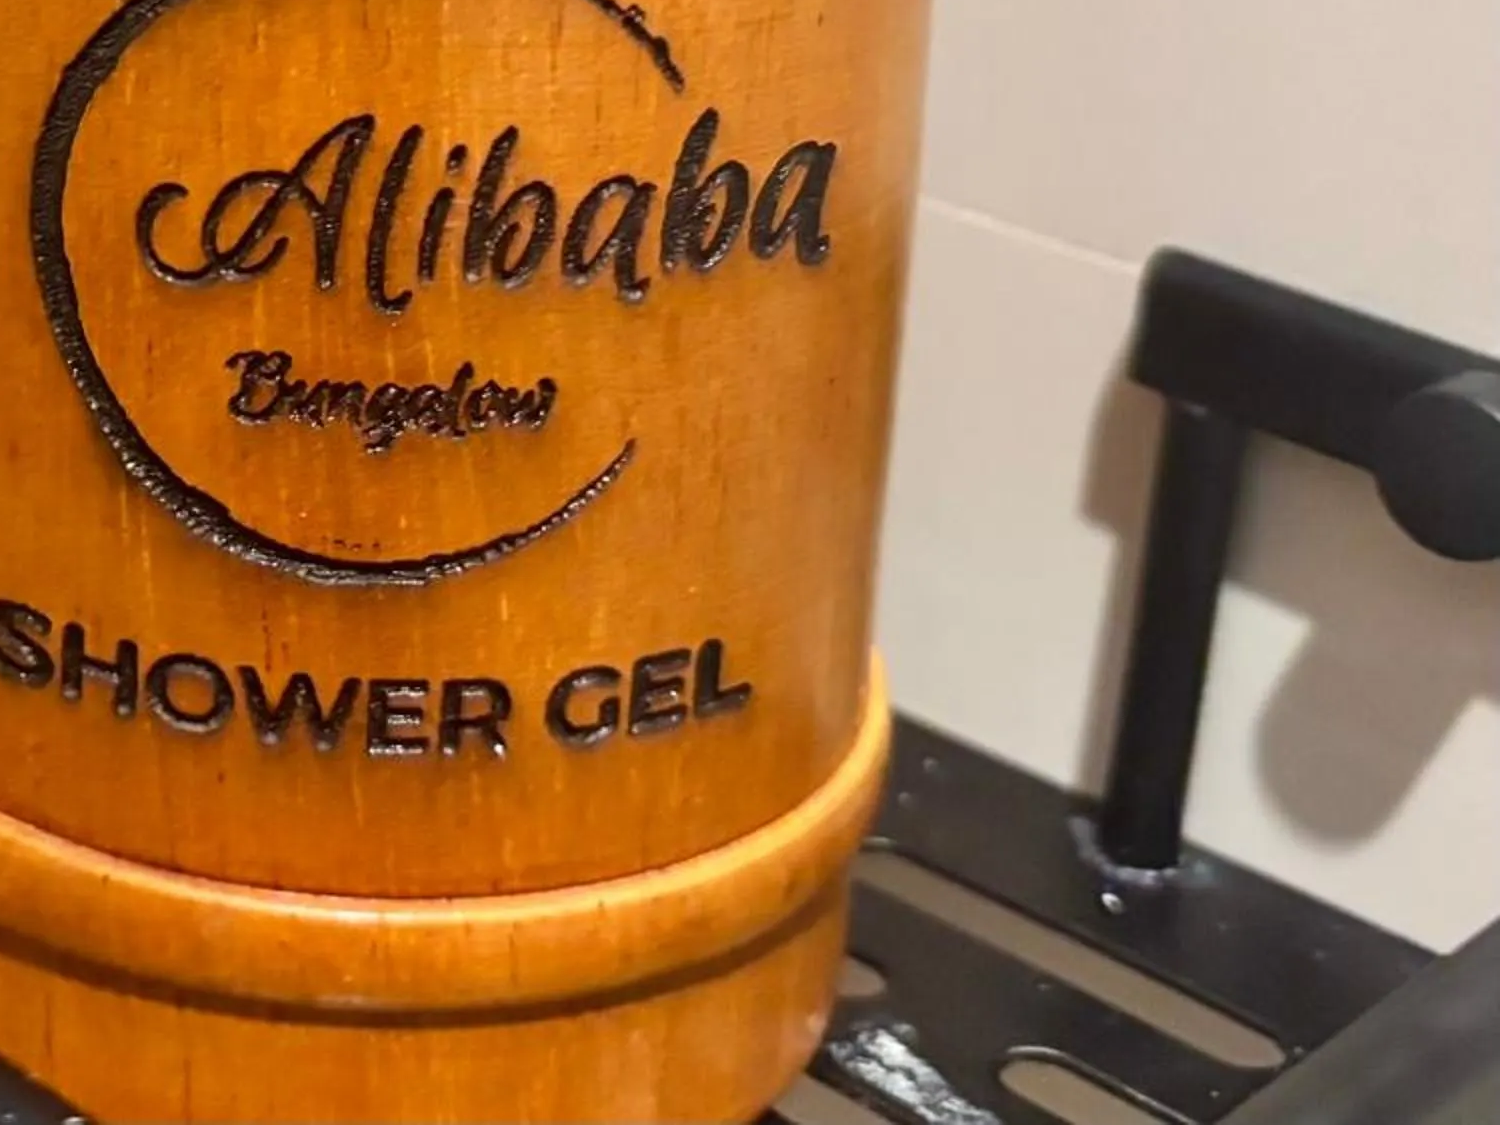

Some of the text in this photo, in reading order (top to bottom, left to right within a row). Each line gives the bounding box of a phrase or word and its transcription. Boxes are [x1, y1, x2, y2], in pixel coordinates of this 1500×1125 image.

[137, 108, 836, 315] Alibaba
[227, 350, 557, 452] Bungalow
[545, 639, 753, 748] GEL
